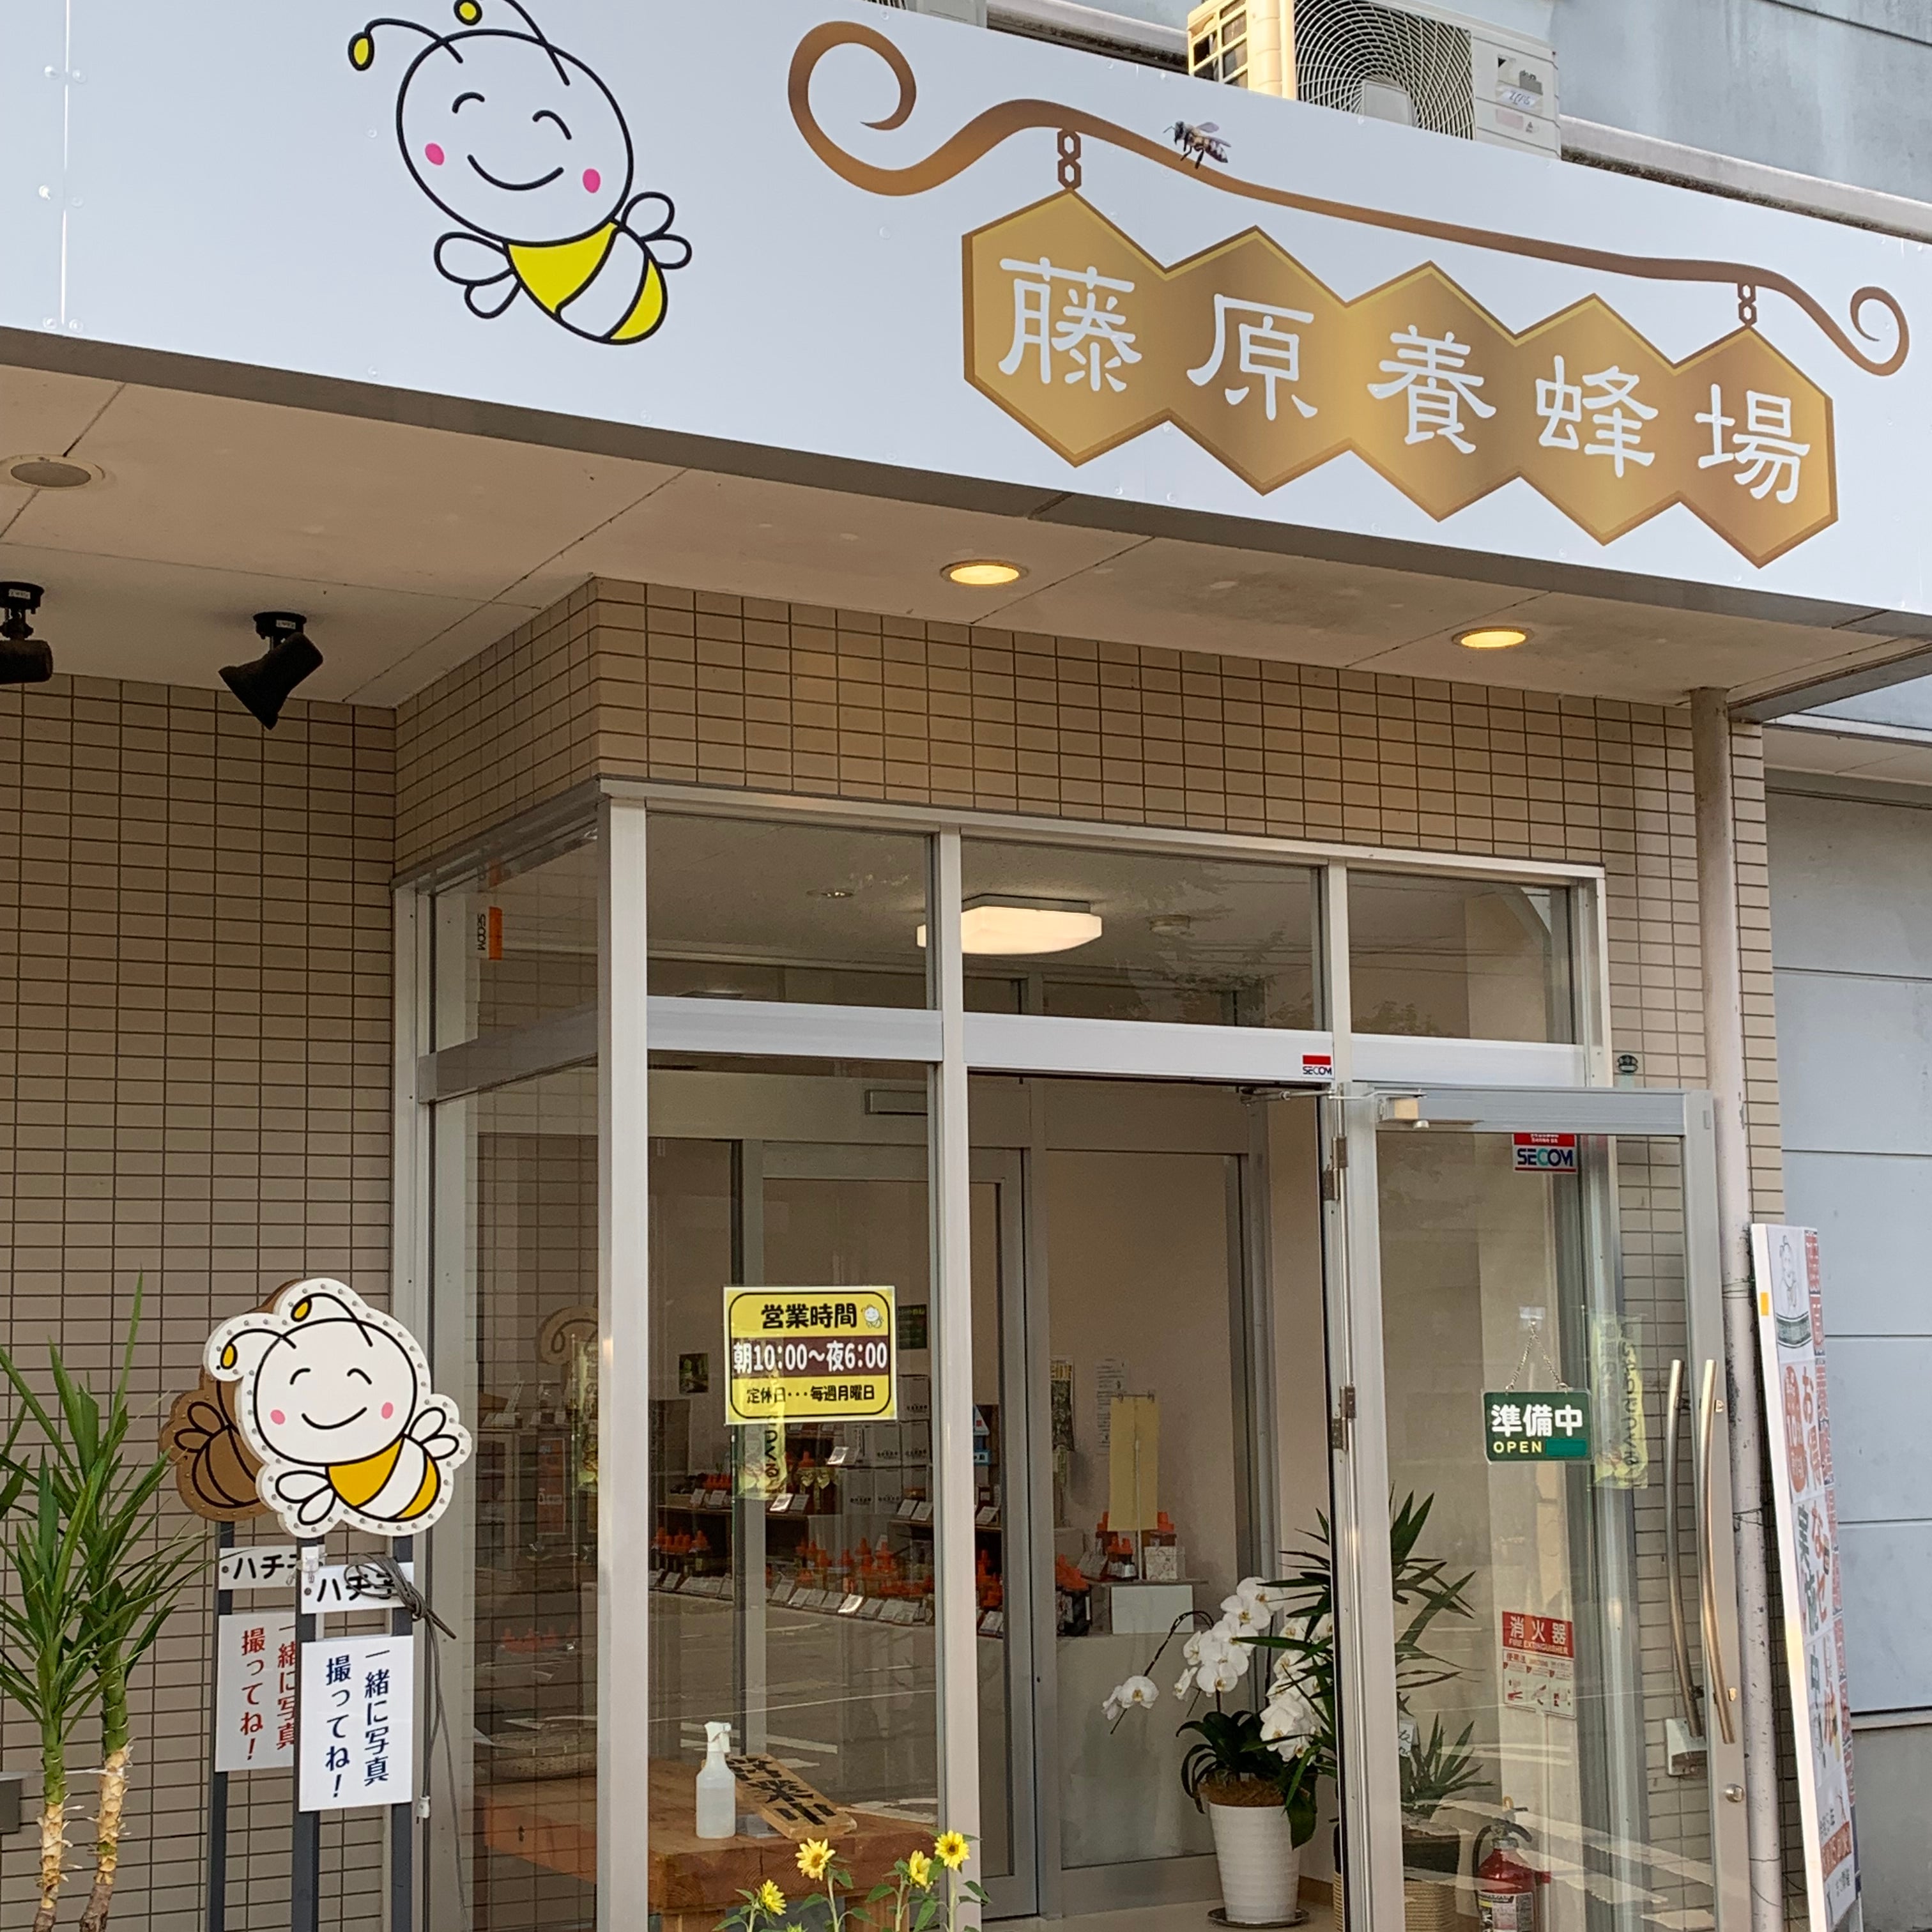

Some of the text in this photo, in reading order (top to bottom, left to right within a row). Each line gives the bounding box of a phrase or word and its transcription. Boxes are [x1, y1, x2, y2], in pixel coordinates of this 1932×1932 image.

[999, 256, 1811, 503] 藤原養蜂場
[1302, 1066, 1332, 1075] SECOM
[1517, 1148, 1574, 1167] SECOM
[761, 1303, 857, 1329] 営業時間
[1491, 1404, 1583, 1437] 準備中
[1492, 1441, 1542, 1453] OPEN
[1510, 1615, 1567, 1645] 消火器
[325, 1654, 351, 1798] 撮ってね！
[364, 1650, 390, 1787] 一緒に写真
